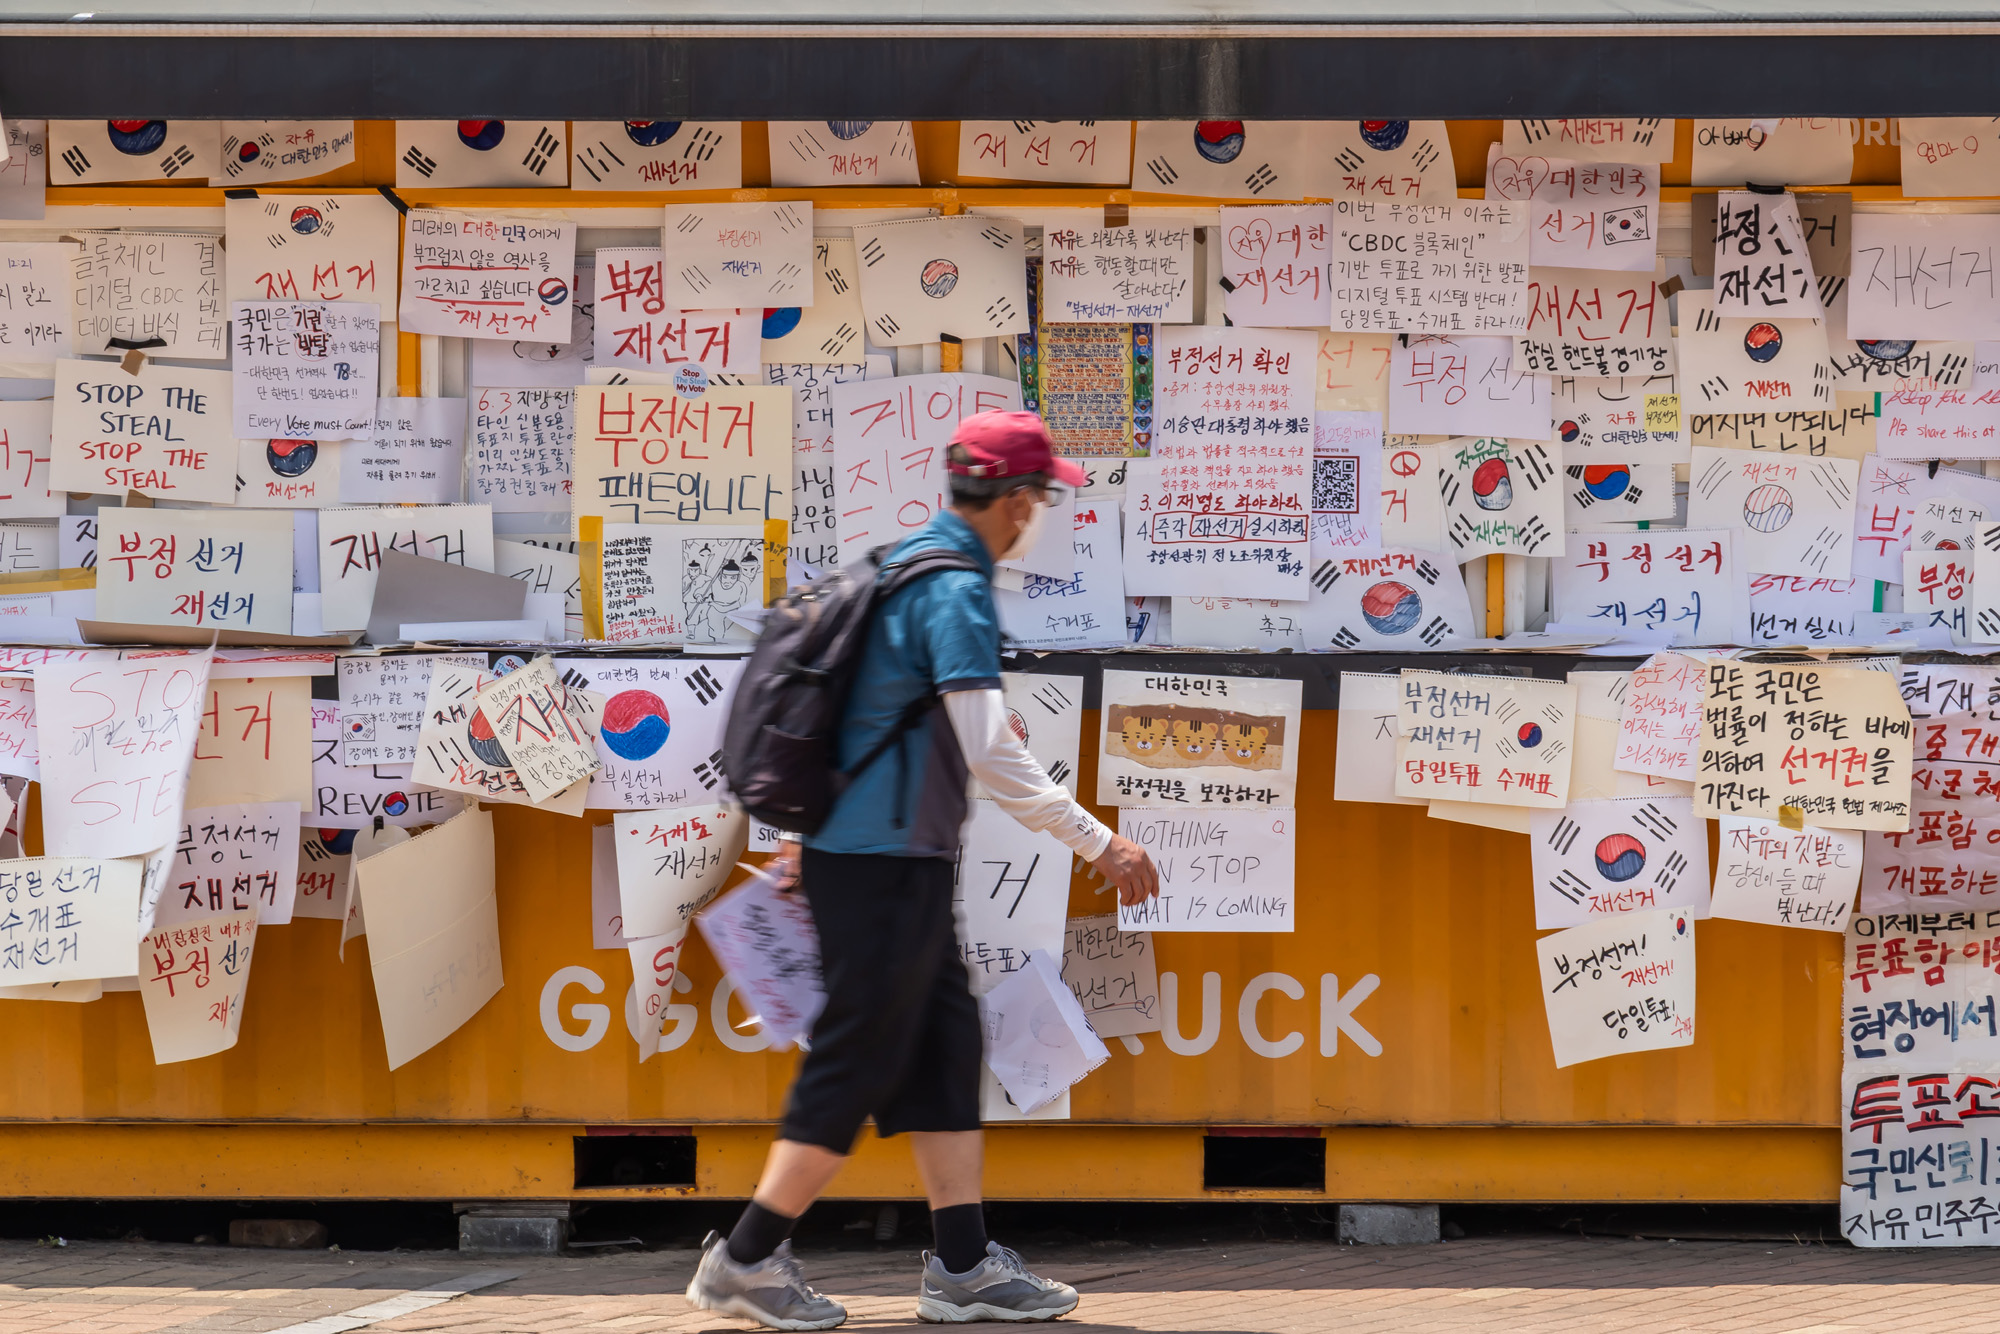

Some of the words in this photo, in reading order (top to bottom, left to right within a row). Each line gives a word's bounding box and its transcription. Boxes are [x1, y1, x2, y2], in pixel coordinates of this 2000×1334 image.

[638, 160, 697, 184] 재선거
[829, 153, 878, 176] 재선거
[1342, 175, 1421, 197] 재선거
[141, 286, 183, 304] CBDC
[613, 319, 731, 368] 재선거
[682, 369, 700, 377] Stop
[1168, 345, 1242, 375] 부정선거
[76, 382, 144, 407] STOP
[161, 387, 208, 415] THE
[676, 384, 687, 393] My
[100, 412, 184, 441] STEAL
[287, 415, 310, 430] Vote
[314, 420, 342, 430] must
[595, 392, 754, 467] 부정선거
[1953, 425, 1977, 439] this
[79, 442, 143, 462] STOP
[162, 449, 208, 470] THE
[104, 468, 176, 489] STEAL
[1743, 463, 1797, 483] 재선거
[265, 482, 315, 500] 재선거
[599, 472, 783, 524] 팩트입니다
[1343, 554, 1416, 578] 재선거
[170, 590, 254, 625] 재선거
[1046, 613, 1101, 632] 수개표
[1145, 677, 1228, 702] 대한민국
[1404, 681, 1490, 719] 부정선거
[1710, 665, 1745, 702] 모든
[1755, 670, 1823, 706] 국민은
[1706, 705, 1767, 746] 법률이
[1784, 710, 1848, 740] 정하는
[1865, 715, 1911, 739] 바에
[1408, 724, 1481, 758] 재선거
[1405, 759, 1482, 792] 당일투표
[1497, 767, 1558, 798] 수개표
[1701, 750, 1764, 775] 의하여
[1780, 745, 1895, 791] 선거권을
[1116, 775, 1189, 803] 참정권을
[1200, 783, 1279, 804] 보장하라
[1126, 820, 1228, 850] NOTHING
[655, 846, 721, 879] 재선거
[1190, 855, 1261, 884] STOP
[1187, 898, 1207, 921] IS
[1215, 895, 1288, 918] COMING
[1588, 888, 1655, 914] 재선거
[1855, 912, 1975, 938] 이제부터
[1849, 938, 1955, 994] 투표함
[1848, 995, 1998, 1059] 현장에서
[1845, 1207, 1909, 1241] 자유
